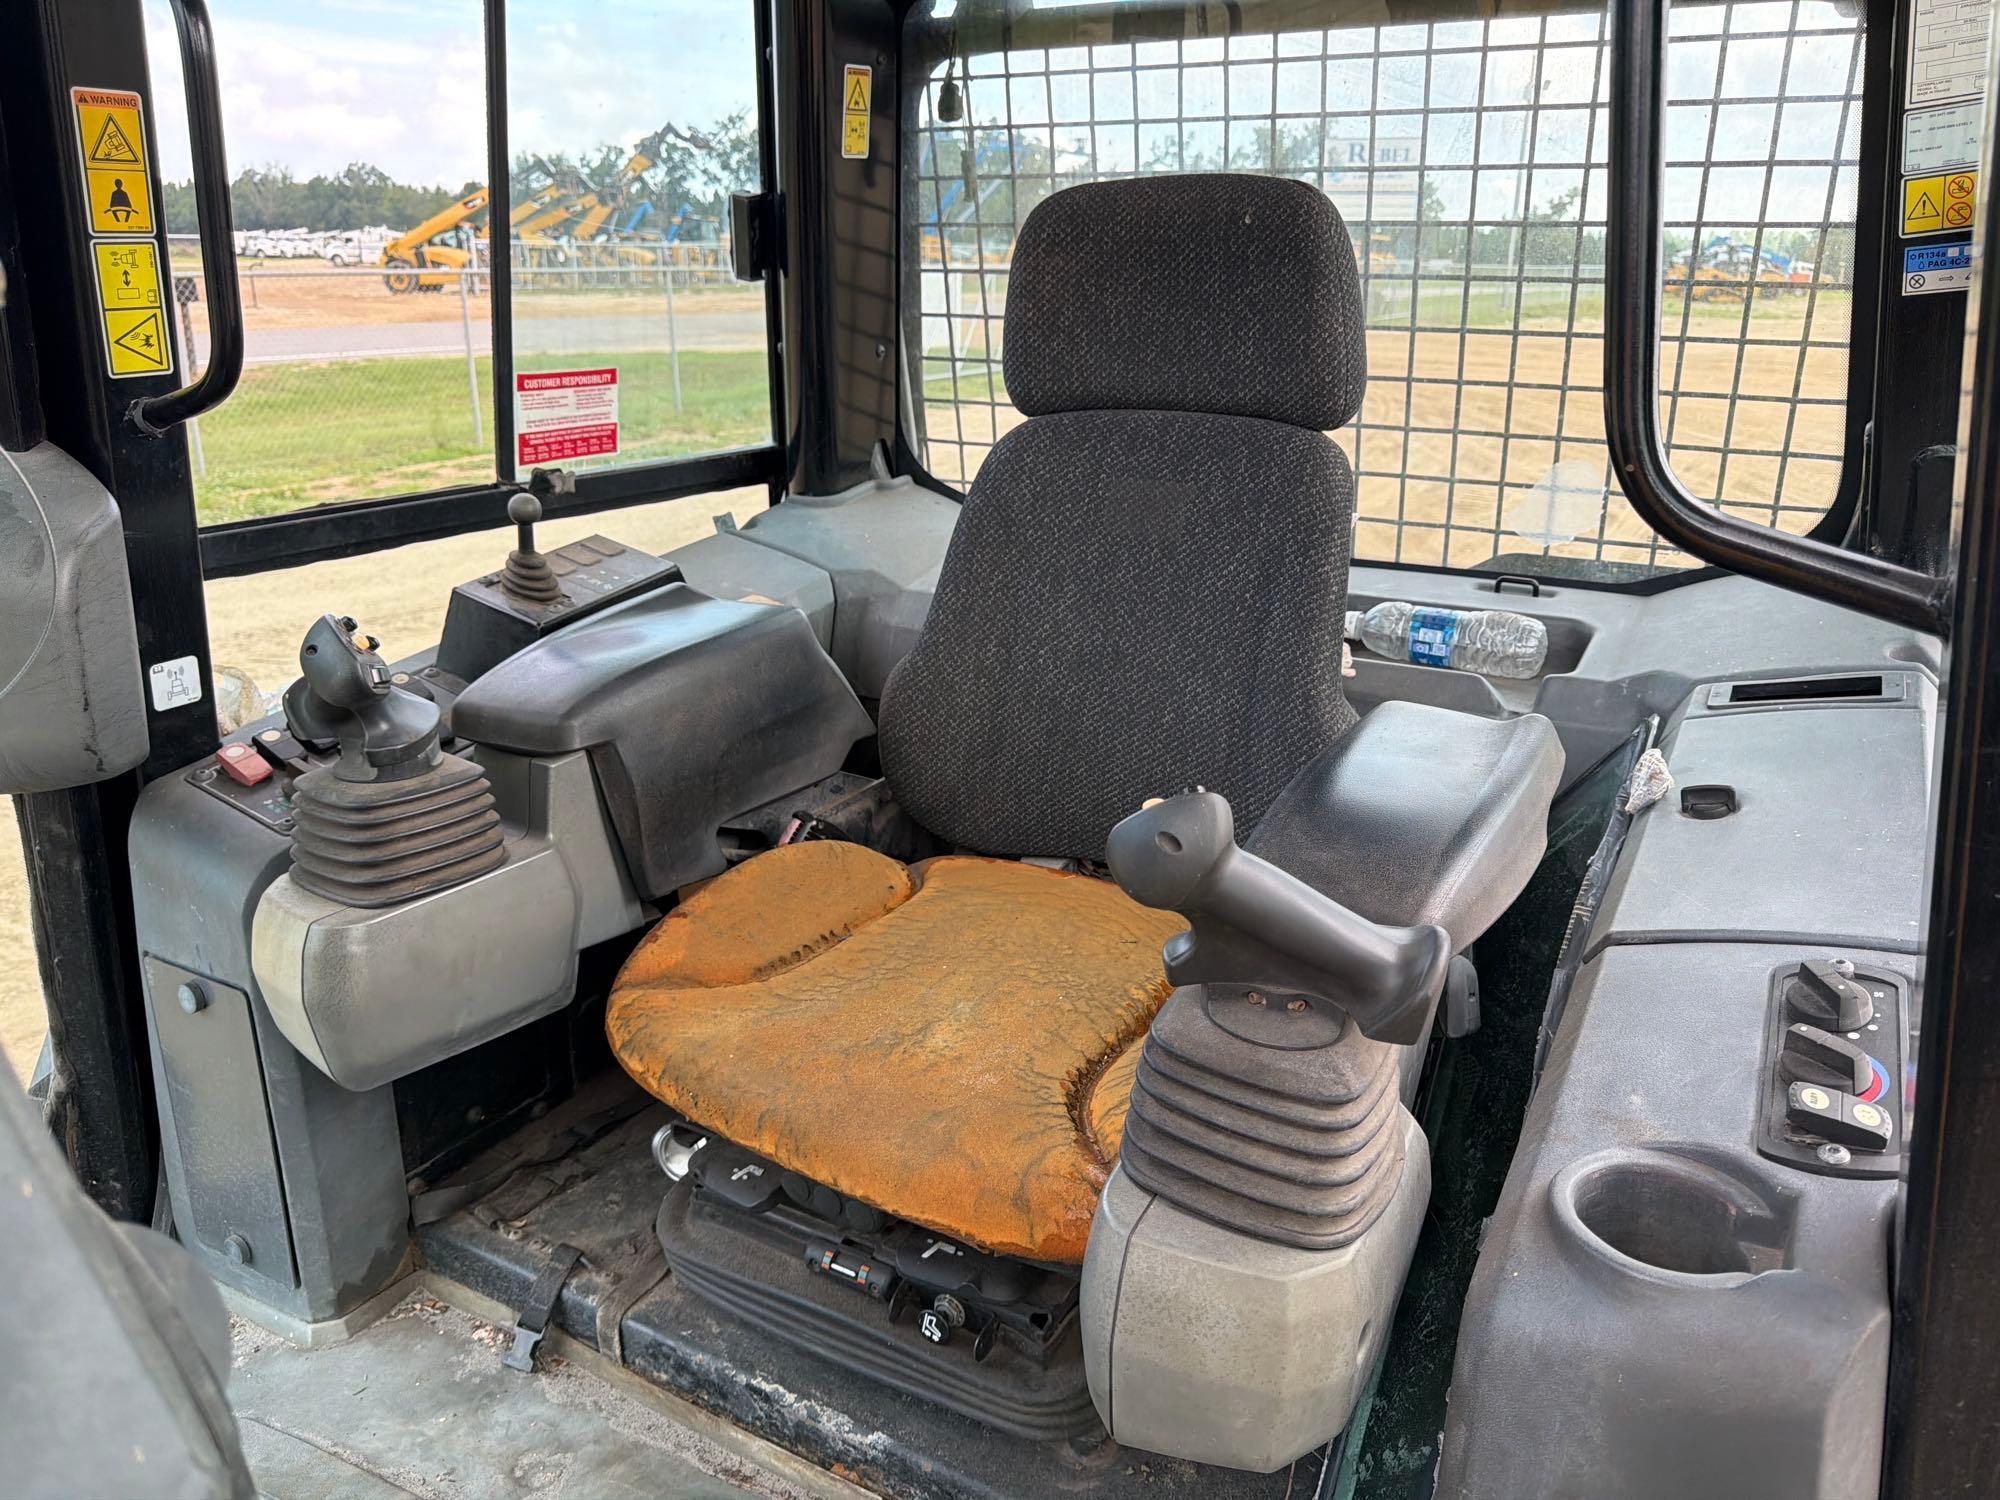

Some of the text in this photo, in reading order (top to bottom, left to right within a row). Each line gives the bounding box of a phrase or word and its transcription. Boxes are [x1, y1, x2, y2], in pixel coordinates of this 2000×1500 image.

[90, 95, 137, 107] WARNING
[1918, 250, 1946, 259] R134a
[524, 373, 612, 389] CUSTOMER RESPONSIBILITY
